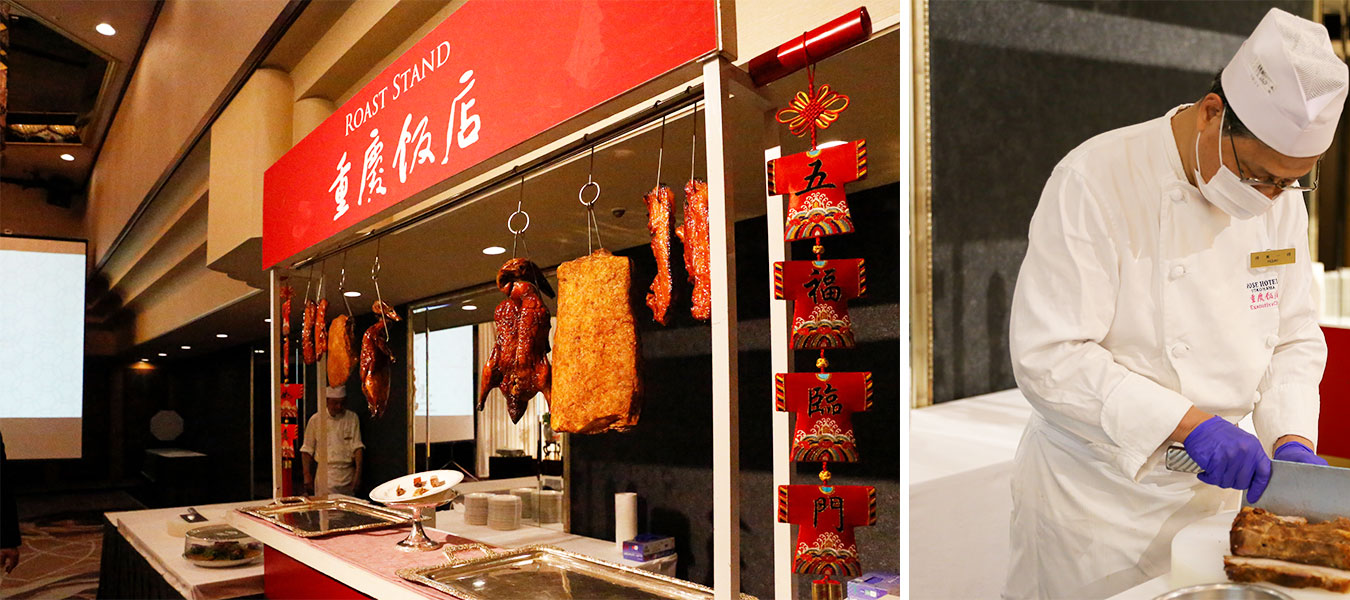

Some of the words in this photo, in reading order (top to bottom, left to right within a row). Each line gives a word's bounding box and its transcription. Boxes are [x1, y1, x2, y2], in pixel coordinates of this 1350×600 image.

[328, 70, 482, 221] 重慶飯店
[344, 86, 388, 136] ROAST
[392, 40, 451, 101] STAND
